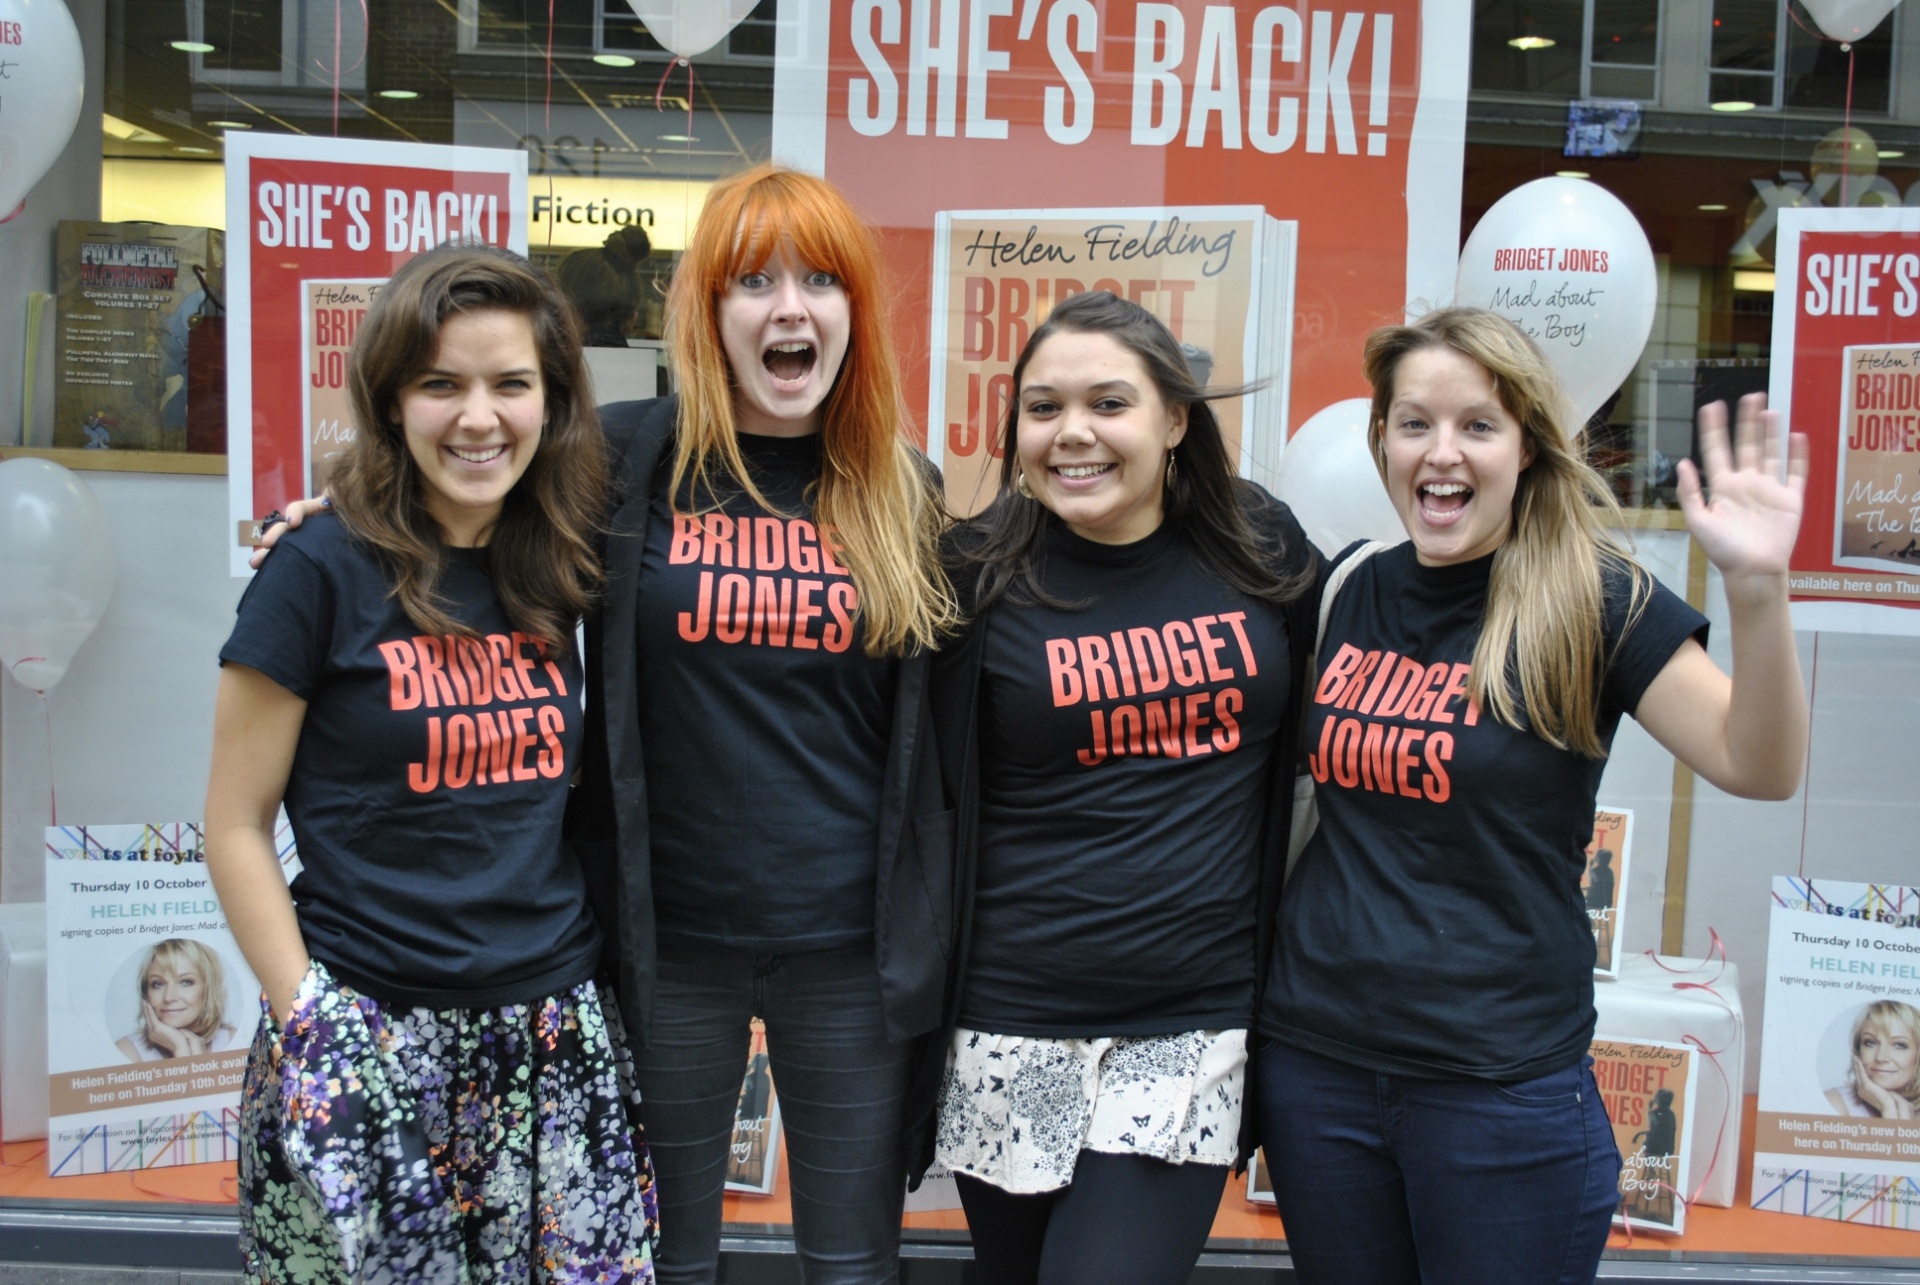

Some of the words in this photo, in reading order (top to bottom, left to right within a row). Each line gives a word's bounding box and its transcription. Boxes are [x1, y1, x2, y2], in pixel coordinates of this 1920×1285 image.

[848, 0, 1098, 145] SHE'S
[1131, 2, 1393, 156] BACK!
[258, 181, 371, 251] SHE'S
[385, 188, 498, 253] BACK!
[532, 195, 654, 227] Fiction
[80, 243, 178, 268] FULLMETAL
[964, 225, 1076, 268] Helen
[1084, 215, 1236, 278] Fielding
[1494, 248, 1556, 272] BRIDGET
[1558, 248, 1609, 273] JONES
[80, 264, 178, 290] ALCHEMIST
[1804, 253, 1920, 317] SHE'S
[315, 285, 365, 304] Helen
[1489, 279, 1541, 310] Mad
[1545, 281, 1605, 308] about
[1544, 314, 1586, 347] Boy
[1857, 351, 1908, 369] Helen
[1846, 473, 1907, 505] Mad
[1855, 509, 1904, 533] The
[1788, 576, 1840, 591] vailable
[1843, 579, 1872, 592] here
[1875, 582, 1892, 593] on
[678, 572, 857, 654] JONES
[379, 632, 568, 711] BRIDGET
[1045, 611, 1258, 708] BRIDGET
[1076, 687, 1244, 767] JONES
[407, 705, 566, 794] JONES
[1308, 715, 1455, 803] JONES
[127, 848, 149, 861] at
[153, 847, 207, 865] foyle
[70, 880, 131, 893] Thursday
[136, 879, 150, 890] 10
[153, 878, 208, 889] October
[90, 902, 157, 919] HELEN
[162, 900, 224, 915] FIELD
[1849, 908, 1871, 921] at
[61, 927, 92, 939] signing
[94, 925, 124, 938] copies
[127, 922, 138, 934] of
[139, 922, 170, 934] Bridget
[1792, 931, 1851, 949] Thursday
[1855, 938, 1869, 949] 10
[1809, 956, 1875, 975] HELEN
[1779, 975, 1810, 987] signing
[1812, 979, 1841, 990] copies
[1843, 980, 1854, 990] of
[1855, 982, 1886, 994] Bridget
[1628, 1043, 1684, 1067] Fielding
[72, 1076, 104, 1089] Helen
[107, 1068, 162, 1084] Fielding's
[165, 1065, 189, 1077] new
[191, 1059, 219, 1073] book
[1591, 1059, 1669, 1094] RIDGET
[89, 1092, 115, 1104] here
[118, 1088, 133, 1099] on
[135, 1081, 187, 1098] Thursday
[191, 1076, 215, 1090] 10th
[58, 1133, 73, 1142] For
[125, 1128, 136, 1137] on
[1778, 1119, 1810, 1132] Helen
[1813, 1121, 1867, 1137] Fielding's
[1870, 1127, 1894, 1137] new
[1897, 1126, 1920, 1138] boo
[1624, 1145, 1680, 1170] about
[1794, 1136, 1819, 1149] here
[1822, 1140, 1837, 1149] on
[1839, 1139, 1892, 1155] Thursday
[1622, 1168, 1660, 1200] Boy
[1761, 1169, 1775, 1178] For
[1826, 1178, 1837, 1186] on
